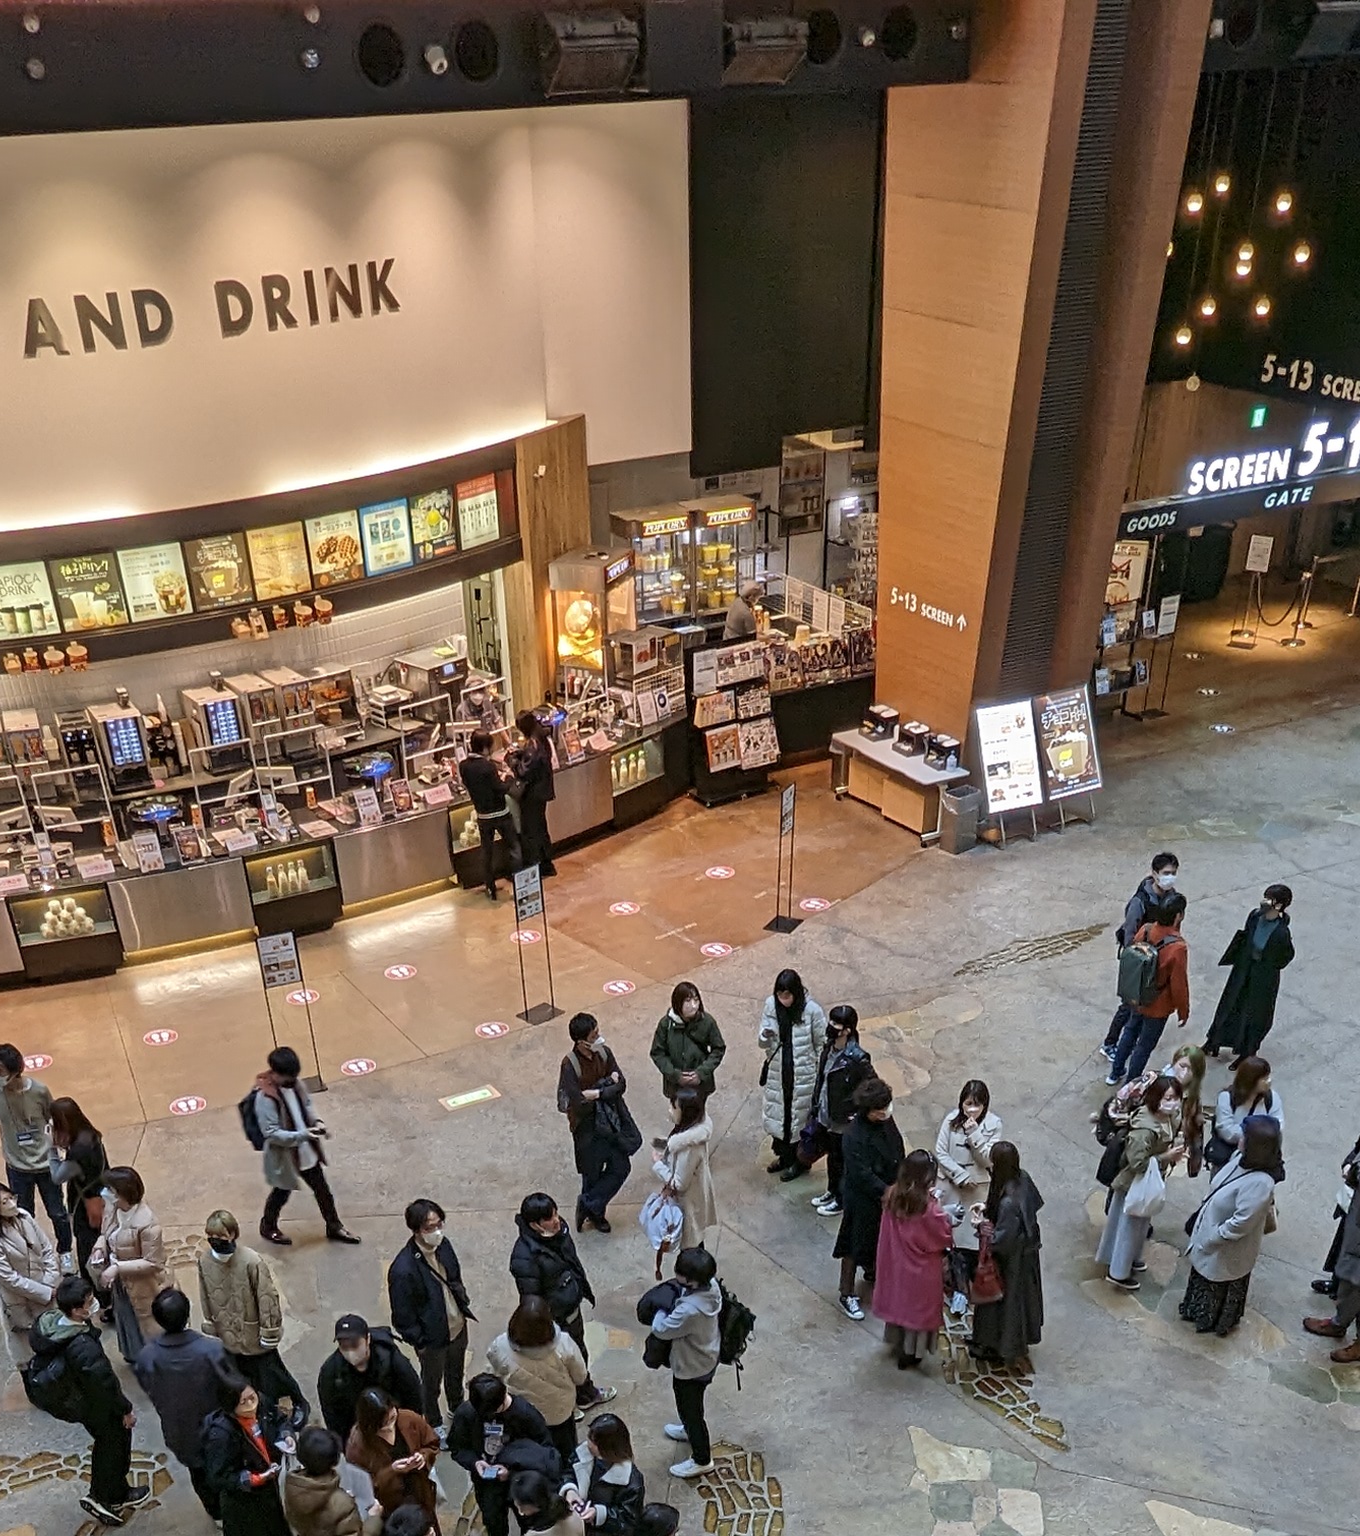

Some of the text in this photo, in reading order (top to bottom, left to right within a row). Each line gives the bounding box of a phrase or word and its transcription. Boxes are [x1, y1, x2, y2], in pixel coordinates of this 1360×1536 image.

[23, 288, 174, 359] AND
[215, 257, 402, 338] DRINK
[1260, 353, 1314, 392] 5-13
[1188, 447, 1291, 496] SCREEN
[1264, 485, 1313, 509] GATE
[644, 518, 688, 534] POPCORN
[709, 507, 752, 524] POPCORN
[1126, 510, 1178, 533] GOODS
[890, 585, 956, 628] 5-13 SCREEN
